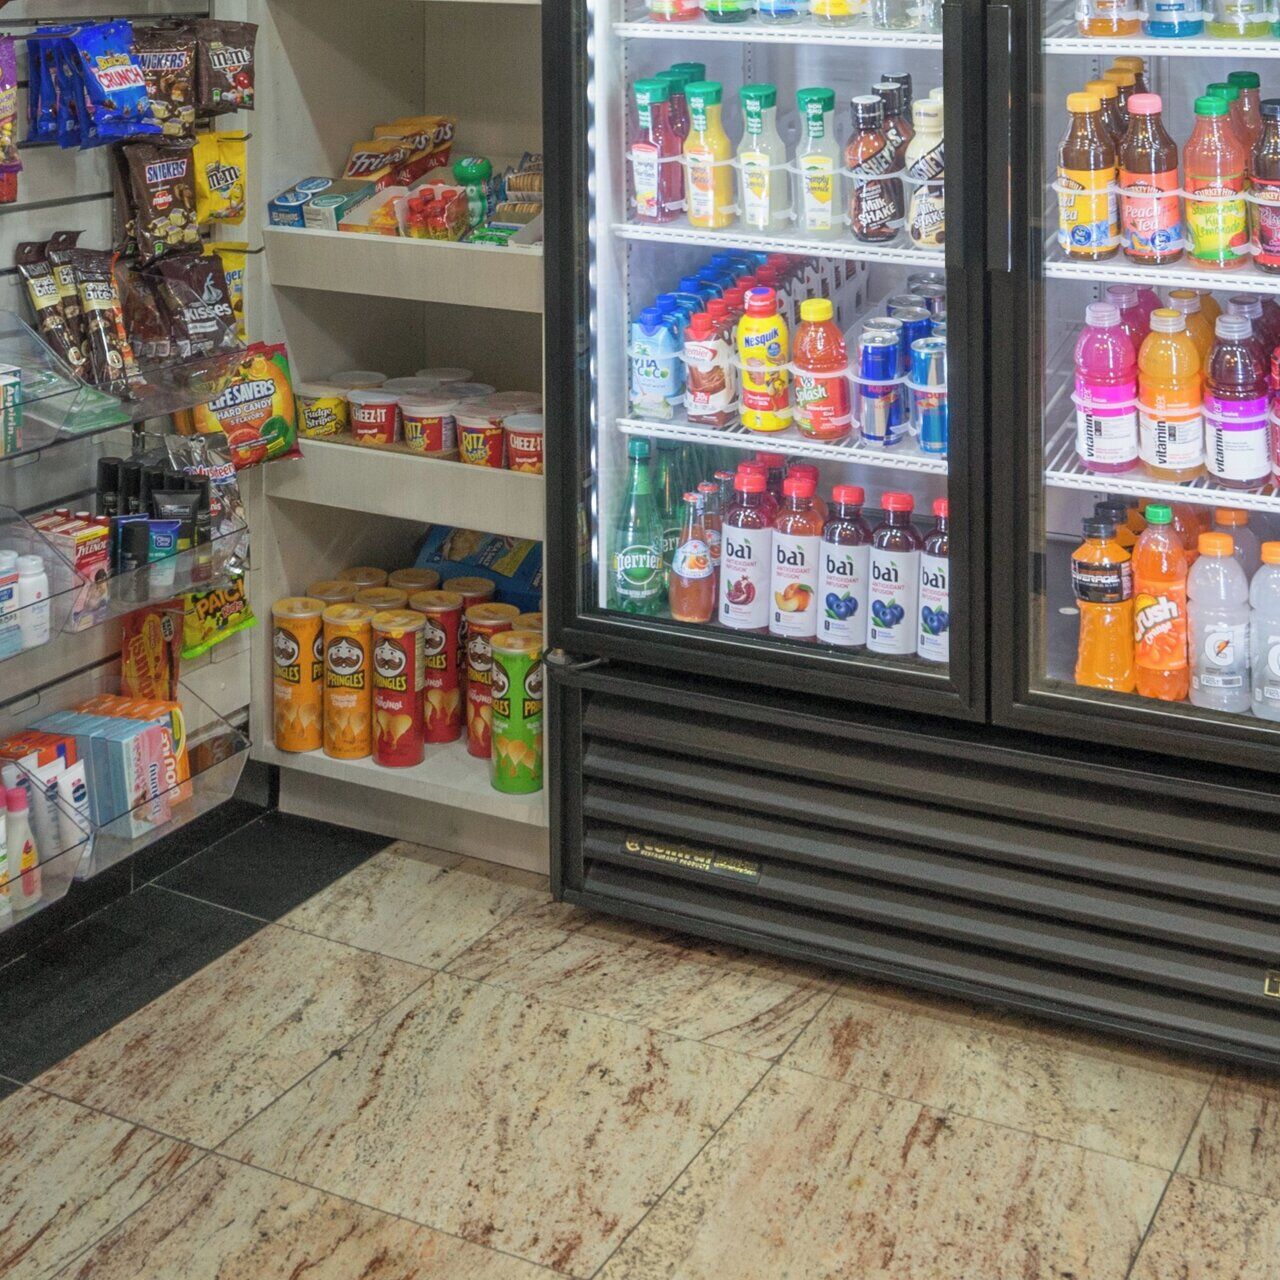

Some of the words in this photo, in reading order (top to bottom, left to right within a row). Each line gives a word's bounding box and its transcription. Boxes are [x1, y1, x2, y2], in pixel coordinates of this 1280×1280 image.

[98, 69, 144, 89] CRUNCH
[147, 161, 186, 182] SNICKERS
[858, 204, 896, 225] SHAKE
[1126, 204, 1161, 219] Peach
[744, 328, 779, 348] Nesquik
[796, 385, 828, 401] Splash
[216, 408, 241, 420] HARD
[243, 398, 272, 412] CANDY
[303, 407, 332, 423] Fudge
[462, 432, 485, 449] RITZ
[726, 537, 752, 559] bai
[776, 544, 806, 566] bai
[826, 555, 855, 575] bai
[872, 561, 899, 582] bai
[922, 565, 946, 588] bai
[327, 673, 364, 688] PRINGLES
